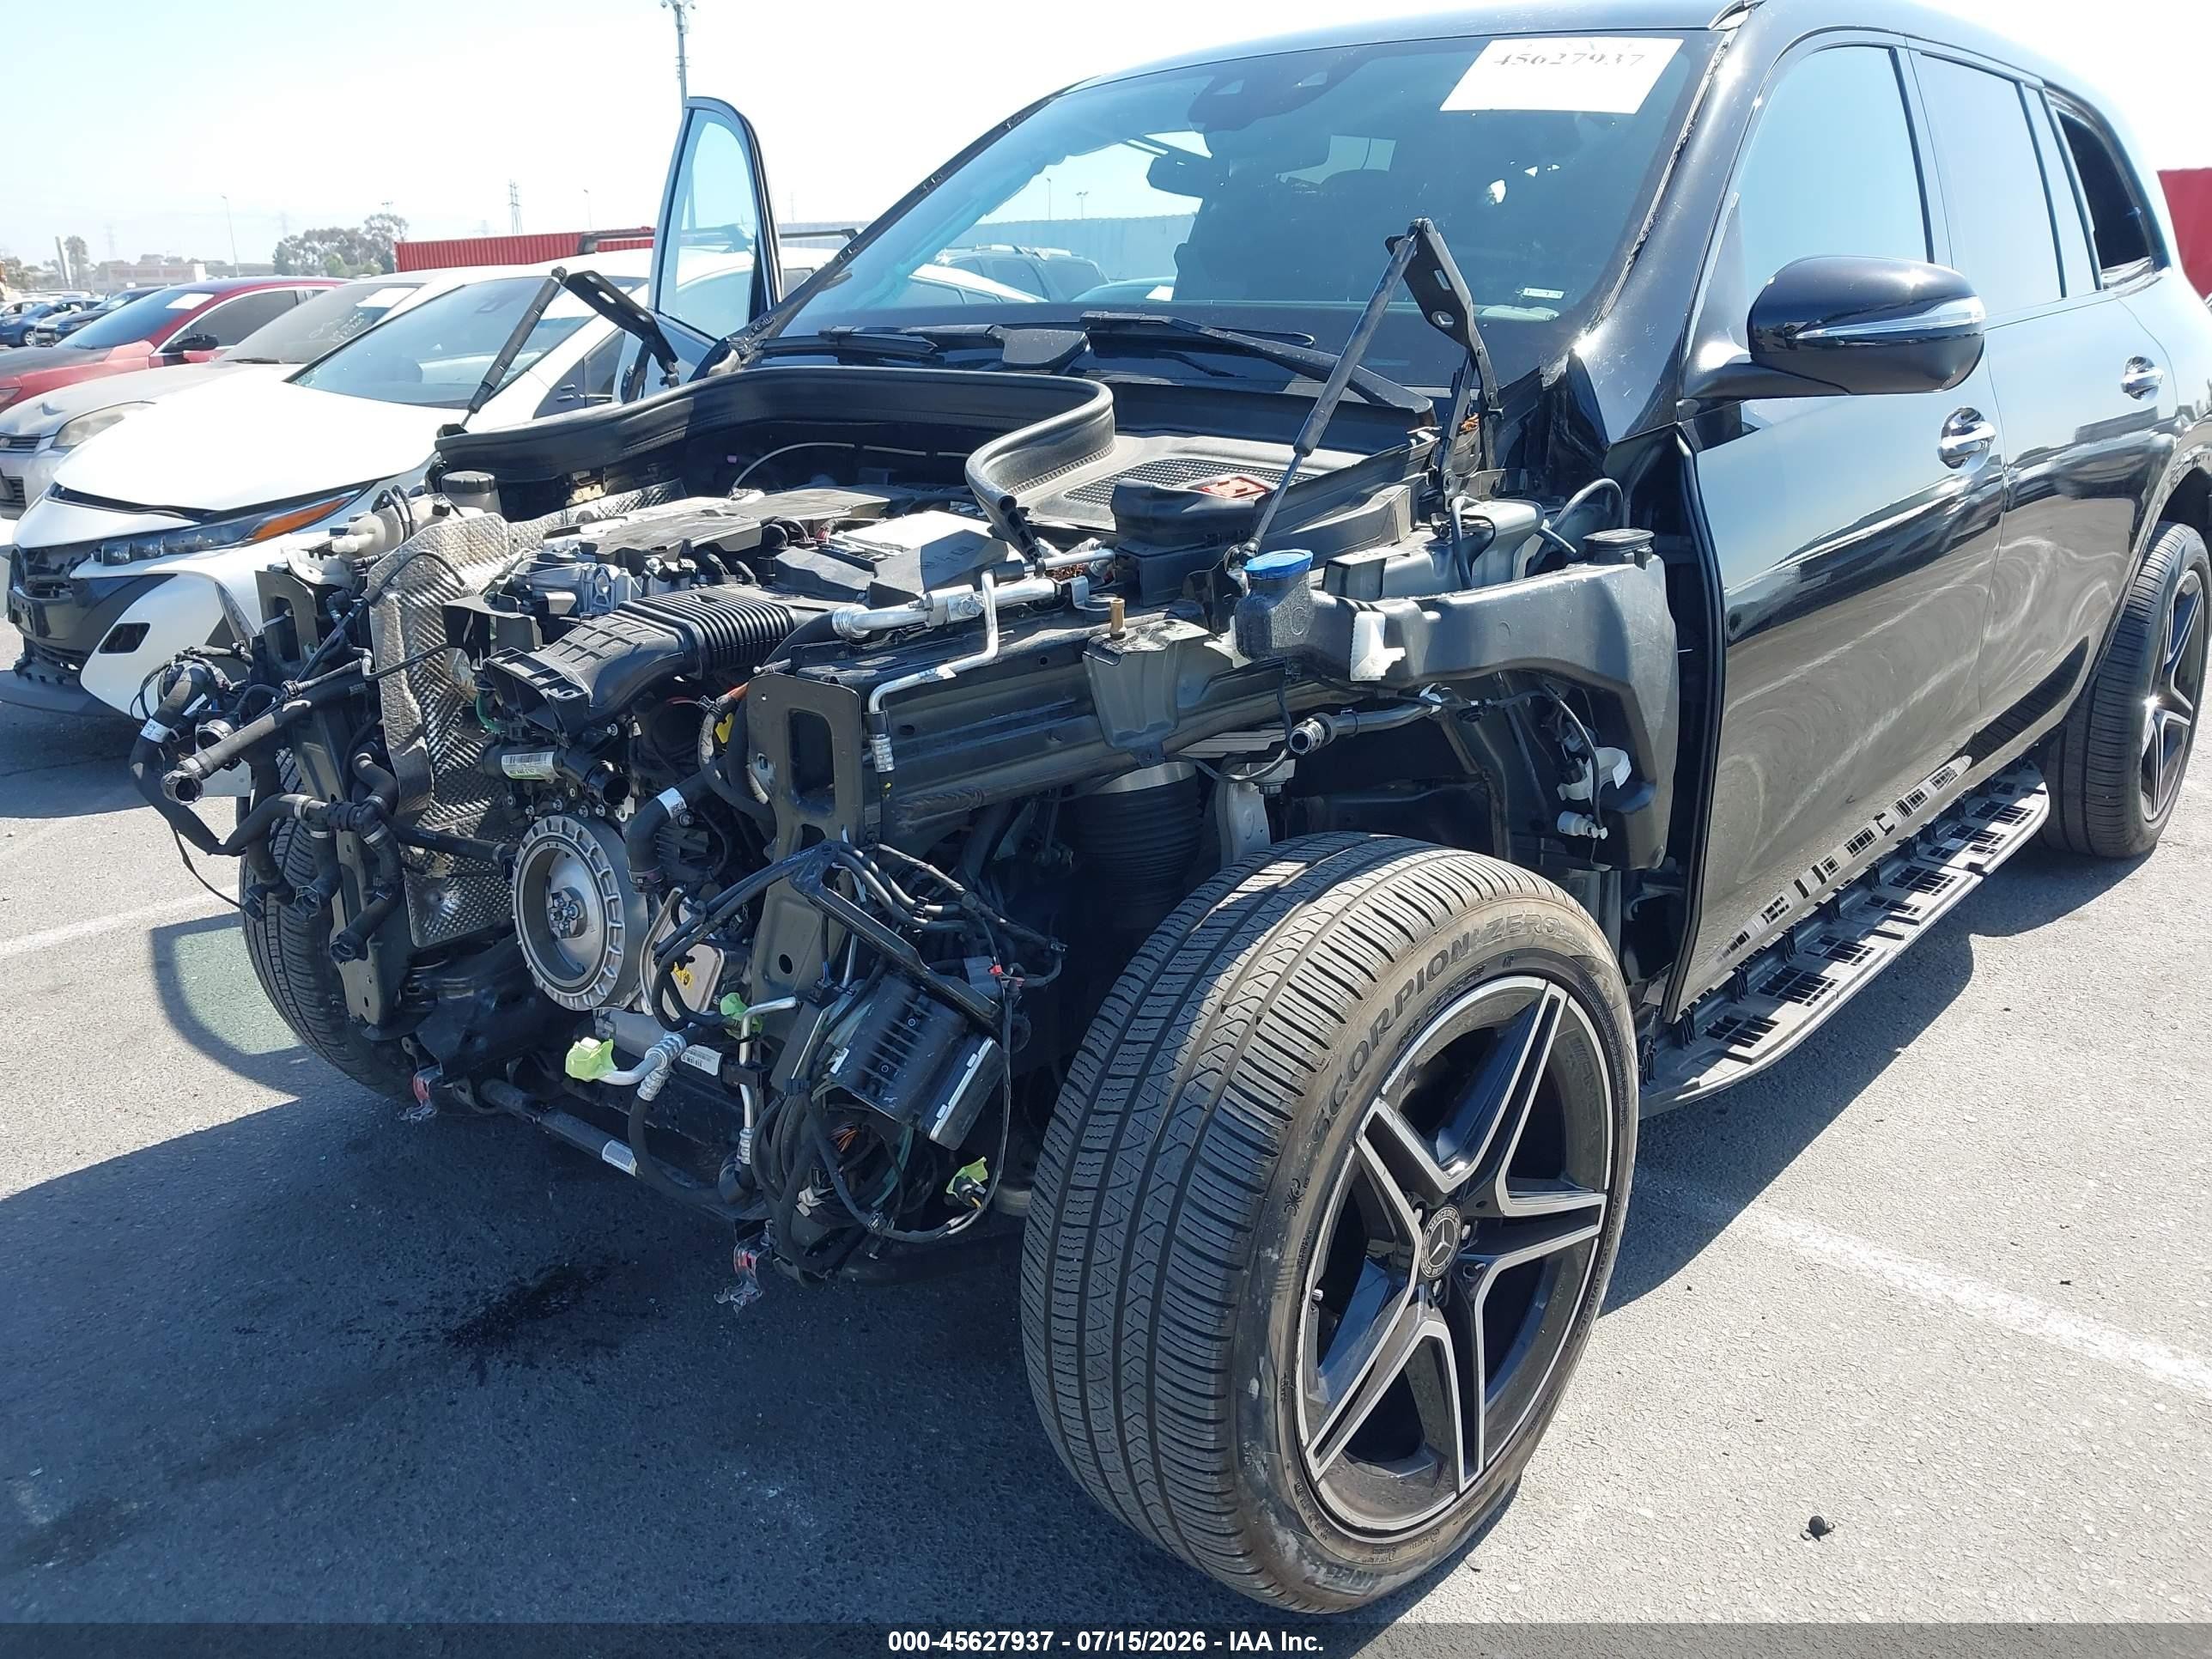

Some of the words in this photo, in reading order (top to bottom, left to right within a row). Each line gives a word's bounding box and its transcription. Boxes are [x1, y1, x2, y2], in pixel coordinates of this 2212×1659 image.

[1311, 933, 1469, 1142] SCORPION
[1485, 913, 1561, 940] ZERO
[1429, 1209, 1456, 1231] MERCEDES
